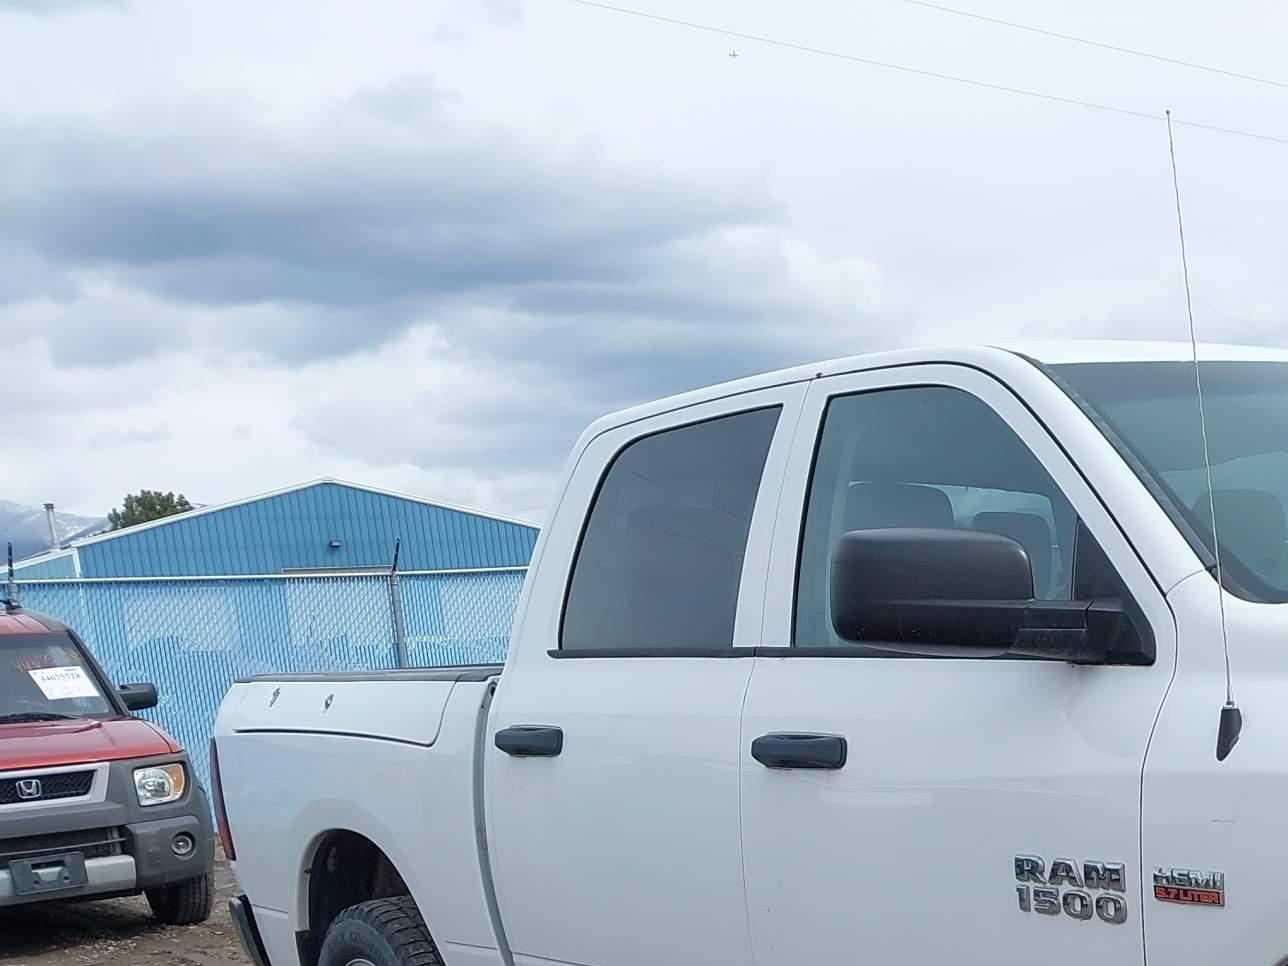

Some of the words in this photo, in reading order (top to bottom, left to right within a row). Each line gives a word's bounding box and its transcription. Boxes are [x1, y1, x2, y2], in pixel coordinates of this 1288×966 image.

[1013, 854, 1127, 893] RAM
[1152, 866, 1225, 890] HEMI
[1015, 884, 1128, 925] 1500
[1155, 886, 1179, 901] 5.7
[1180, 888, 1221, 905] LITER
